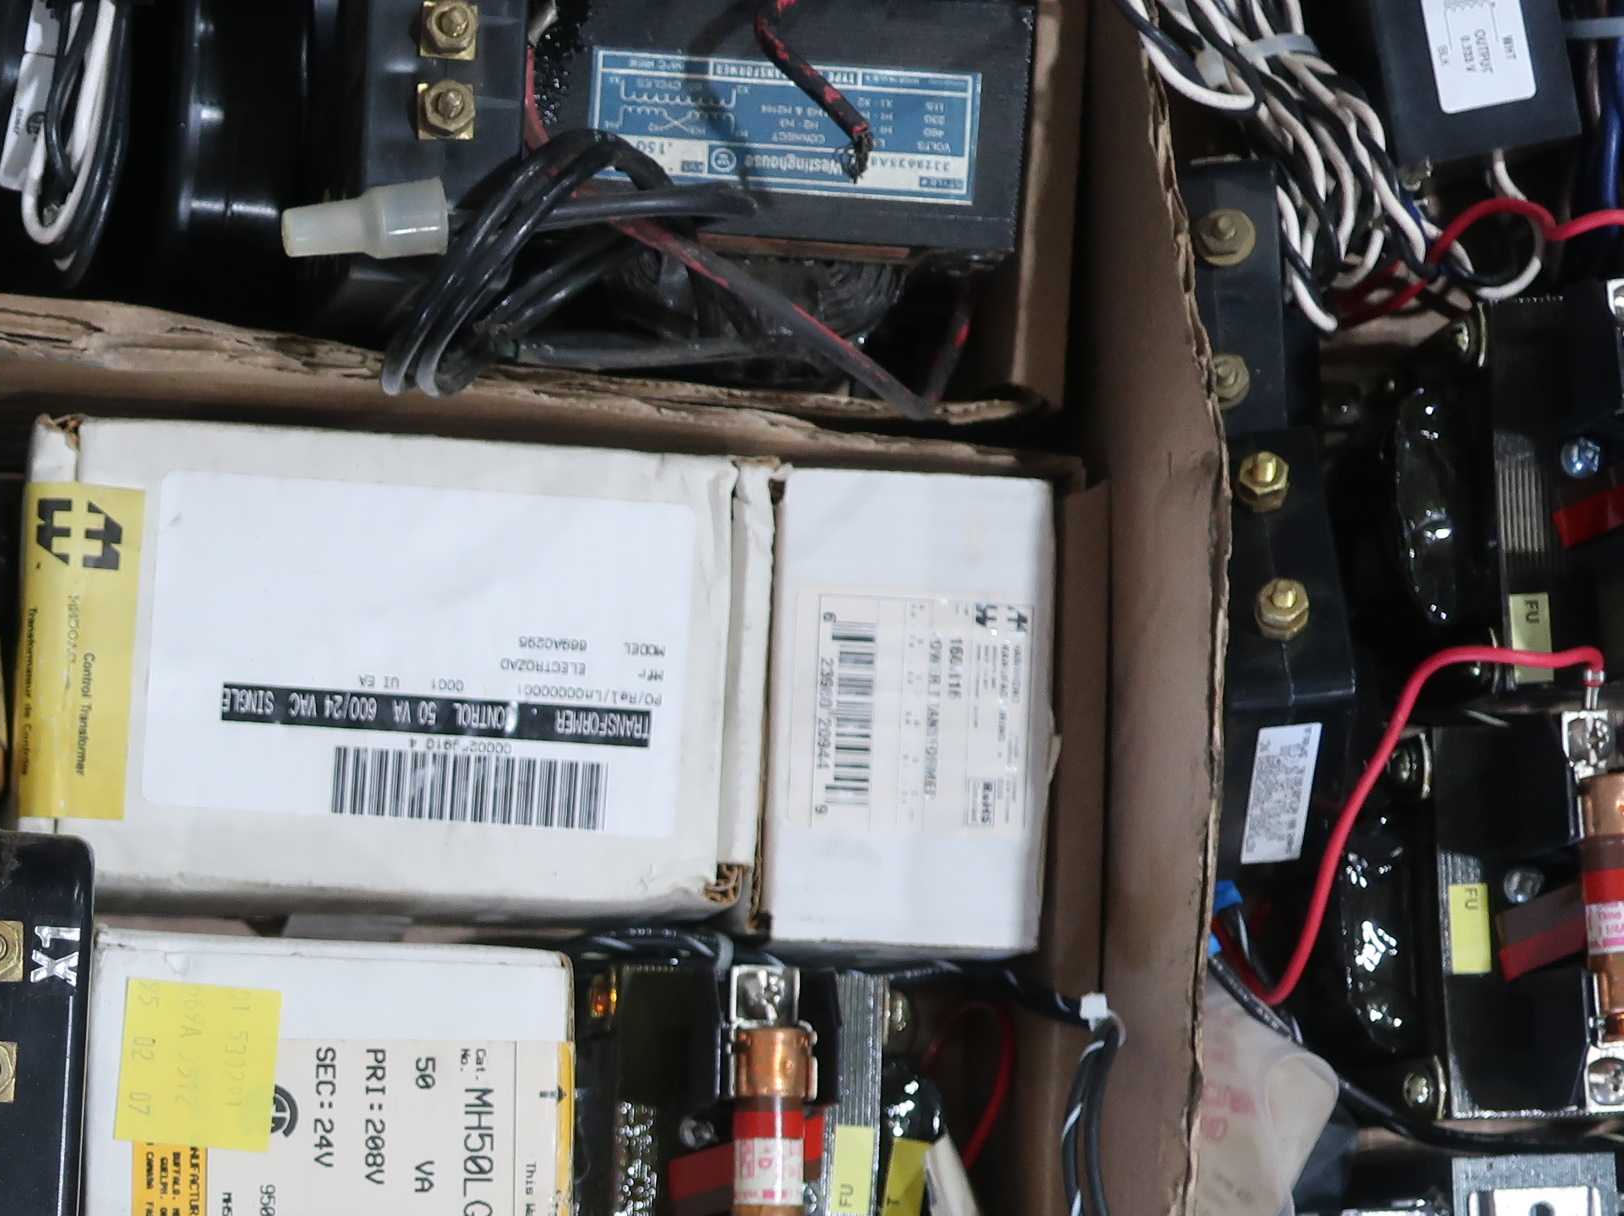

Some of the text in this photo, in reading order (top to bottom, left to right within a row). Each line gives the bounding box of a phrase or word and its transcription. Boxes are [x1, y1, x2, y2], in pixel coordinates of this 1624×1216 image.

[744, 154, 843, 176] Westinghouse
[1524, 600, 1539, 624] FU
[24, 608, 39, 698] Transformateur
[624, 642, 665, 657] MODEL
[500, 658, 586, 676] ELECTROZAD
[359, 674, 375, 688] EA
[74, 651, 96, 776] Control Transformer
[222, 686, 275, 715] SINGLE
[288, 691, 317, 717] VAC
[324, 692, 378, 722] 600/24
[392, 699, 411, 724] VA
[418, 700, 436, 726] 50
[555, 708, 650, 741] TRANSFORMER
[1466, 888, 1478, 910] FU
[30, 925, 81, 987] X1
[415, 1056, 436, 1090] 50
[459, 1048, 471, 1072] No.
[474, 1049, 487, 1081] Cat.
[413, 1160, 434, 1193] VA
[524, 1162, 537, 1195] This
[840, 1184, 854, 1208] FU
